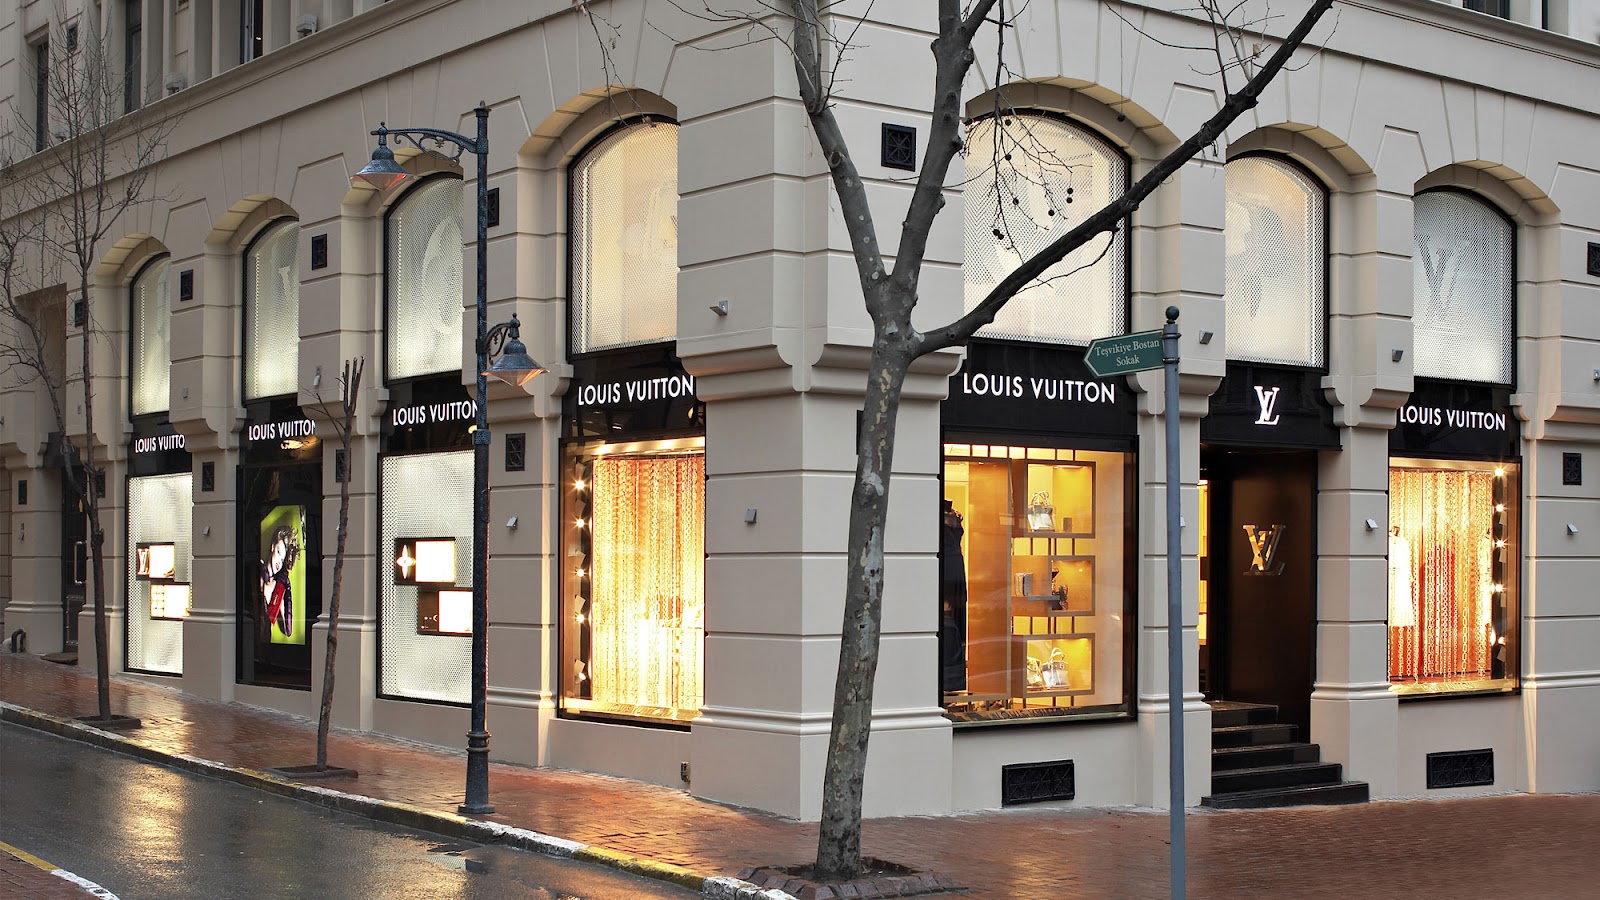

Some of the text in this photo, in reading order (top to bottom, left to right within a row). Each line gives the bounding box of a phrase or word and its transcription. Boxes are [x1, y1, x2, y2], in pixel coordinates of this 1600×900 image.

[1094, 340, 1160, 357] Teşvikiye Bostan
[1116, 355, 1140, 367] Sokak
[578, 374, 694, 406] LOUIS VUITTON
[963, 372, 1115, 404] LOUIS VUITTON
[392, 405, 426, 426] LOUIS
[1400, 405, 1506, 431] LOUIS VUITTON
[248, 422, 276, 441] LOUIS
[134, 434, 185, 453] LOUIS VUITTO
